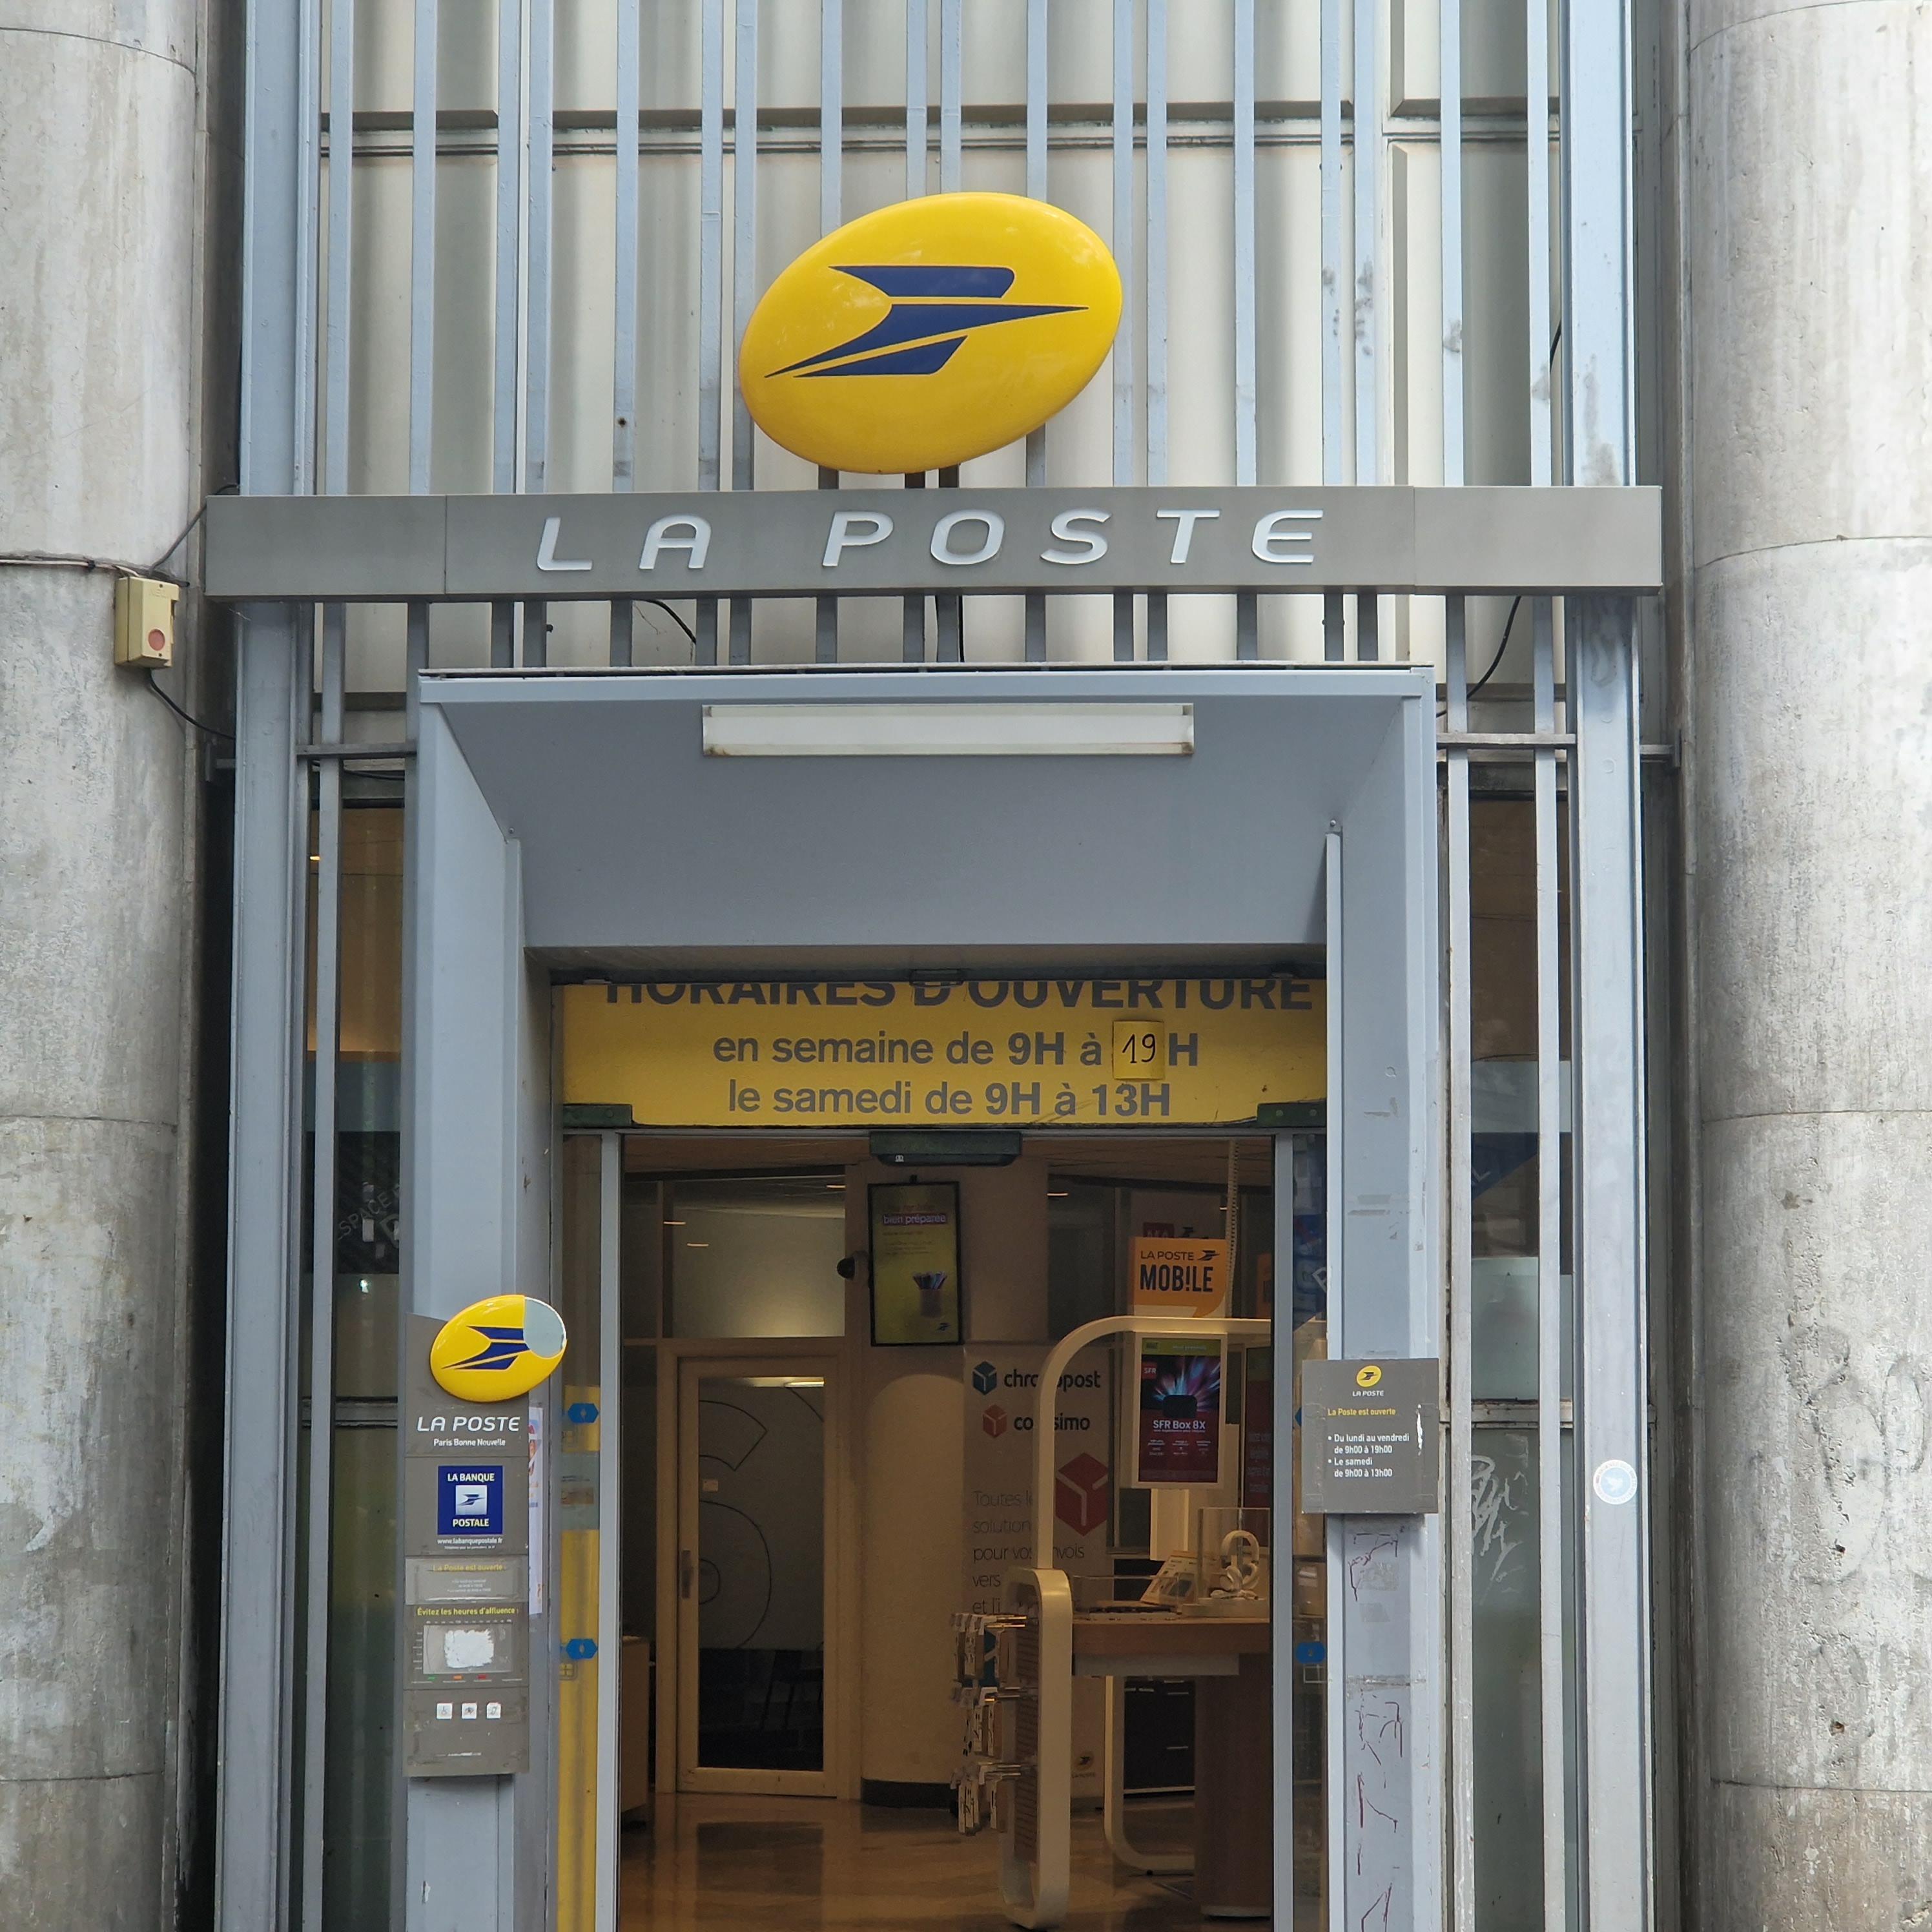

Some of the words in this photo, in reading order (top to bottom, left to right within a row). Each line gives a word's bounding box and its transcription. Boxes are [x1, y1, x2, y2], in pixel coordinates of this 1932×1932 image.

[536, 515, 713, 573] LA
[821, 508, 1325, 568] POSTE
[606, 981, 896, 1007] HORAIRES
[913, 978, 1313, 1011] DOUVERTURE
[713, 1037, 759, 1062] en
[772, 1030, 934, 1064] semaine
[945, 1032, 994, 1065] de
[1008, 1031, 1065, 1065] 9H
[1080, 1034, 1102, 1065] à
[729, 1078, 761, 1113] le
[772, 1081, 912, 1114] samedi
[925, 1082, 973, 1116] de
[985, 1082, 1040, 1116] 9H
[1054, 1082, 1076, 1116] à
[1092, 1083, 1170, 1116] 13H
[1140, 1250, 1155, 1260] LA
[1157, 1251, 1194, 1261] POSTE
[1003, 1368, 1101, 1392] chropost
[416, 1416, 446, 1432] LA
[453, 1416, 520, 1432] POSTE
[1014, 1413, 1090, 1430] cosimo
[1153, 1419, 1171, 1430] SFR
[1172, 1420, 1191, 1430] Box
[1193, 1420, 1206, 1430] 8X
[433, 1438, 453, 1446] Paris
[454, 1438, 476, 1446] Bonne
[477, 1438, 506, 1446] Nouvelle
[1346, 1434, 1365, 1442] lundi
[1377, 1434, 1410, 1442] vendredi
[1334, 1446, 1344, 1454] de
[1345, 1446, 1362, 1454] 9h00
[1364, 1445, 1370, 1454] à
[1371, 1445, 1393, 1454] 19h00
[1334, 1457, 1344, 1466] Le
[1345, 1457, 1373, 1466] samedi
[447, 1473, 458, 1482] LA
[459, 1472, 495, 1483] BANQUE
[1334, 1469, 1344, 1477] de
[1345, 1469, 1362, 1477] 9h00
[1364, 1468, 1370, 1477] à
[1371, 1469, 1393, 1477] 13h00
[452, 1518, 489, 1527] POSTALE
[972, 1518, 1032, 1534] solution
[972, 1547, 1009, 1563] pour
[1053, 1543, 1085, 1559] nvois
[972, 1574, 1002, 1587] vers
[417, 1606, 439, 1616] Évitez
[479, 1607, 515, 1615] d'affluence
[972, 1598, 987, 1614] et
